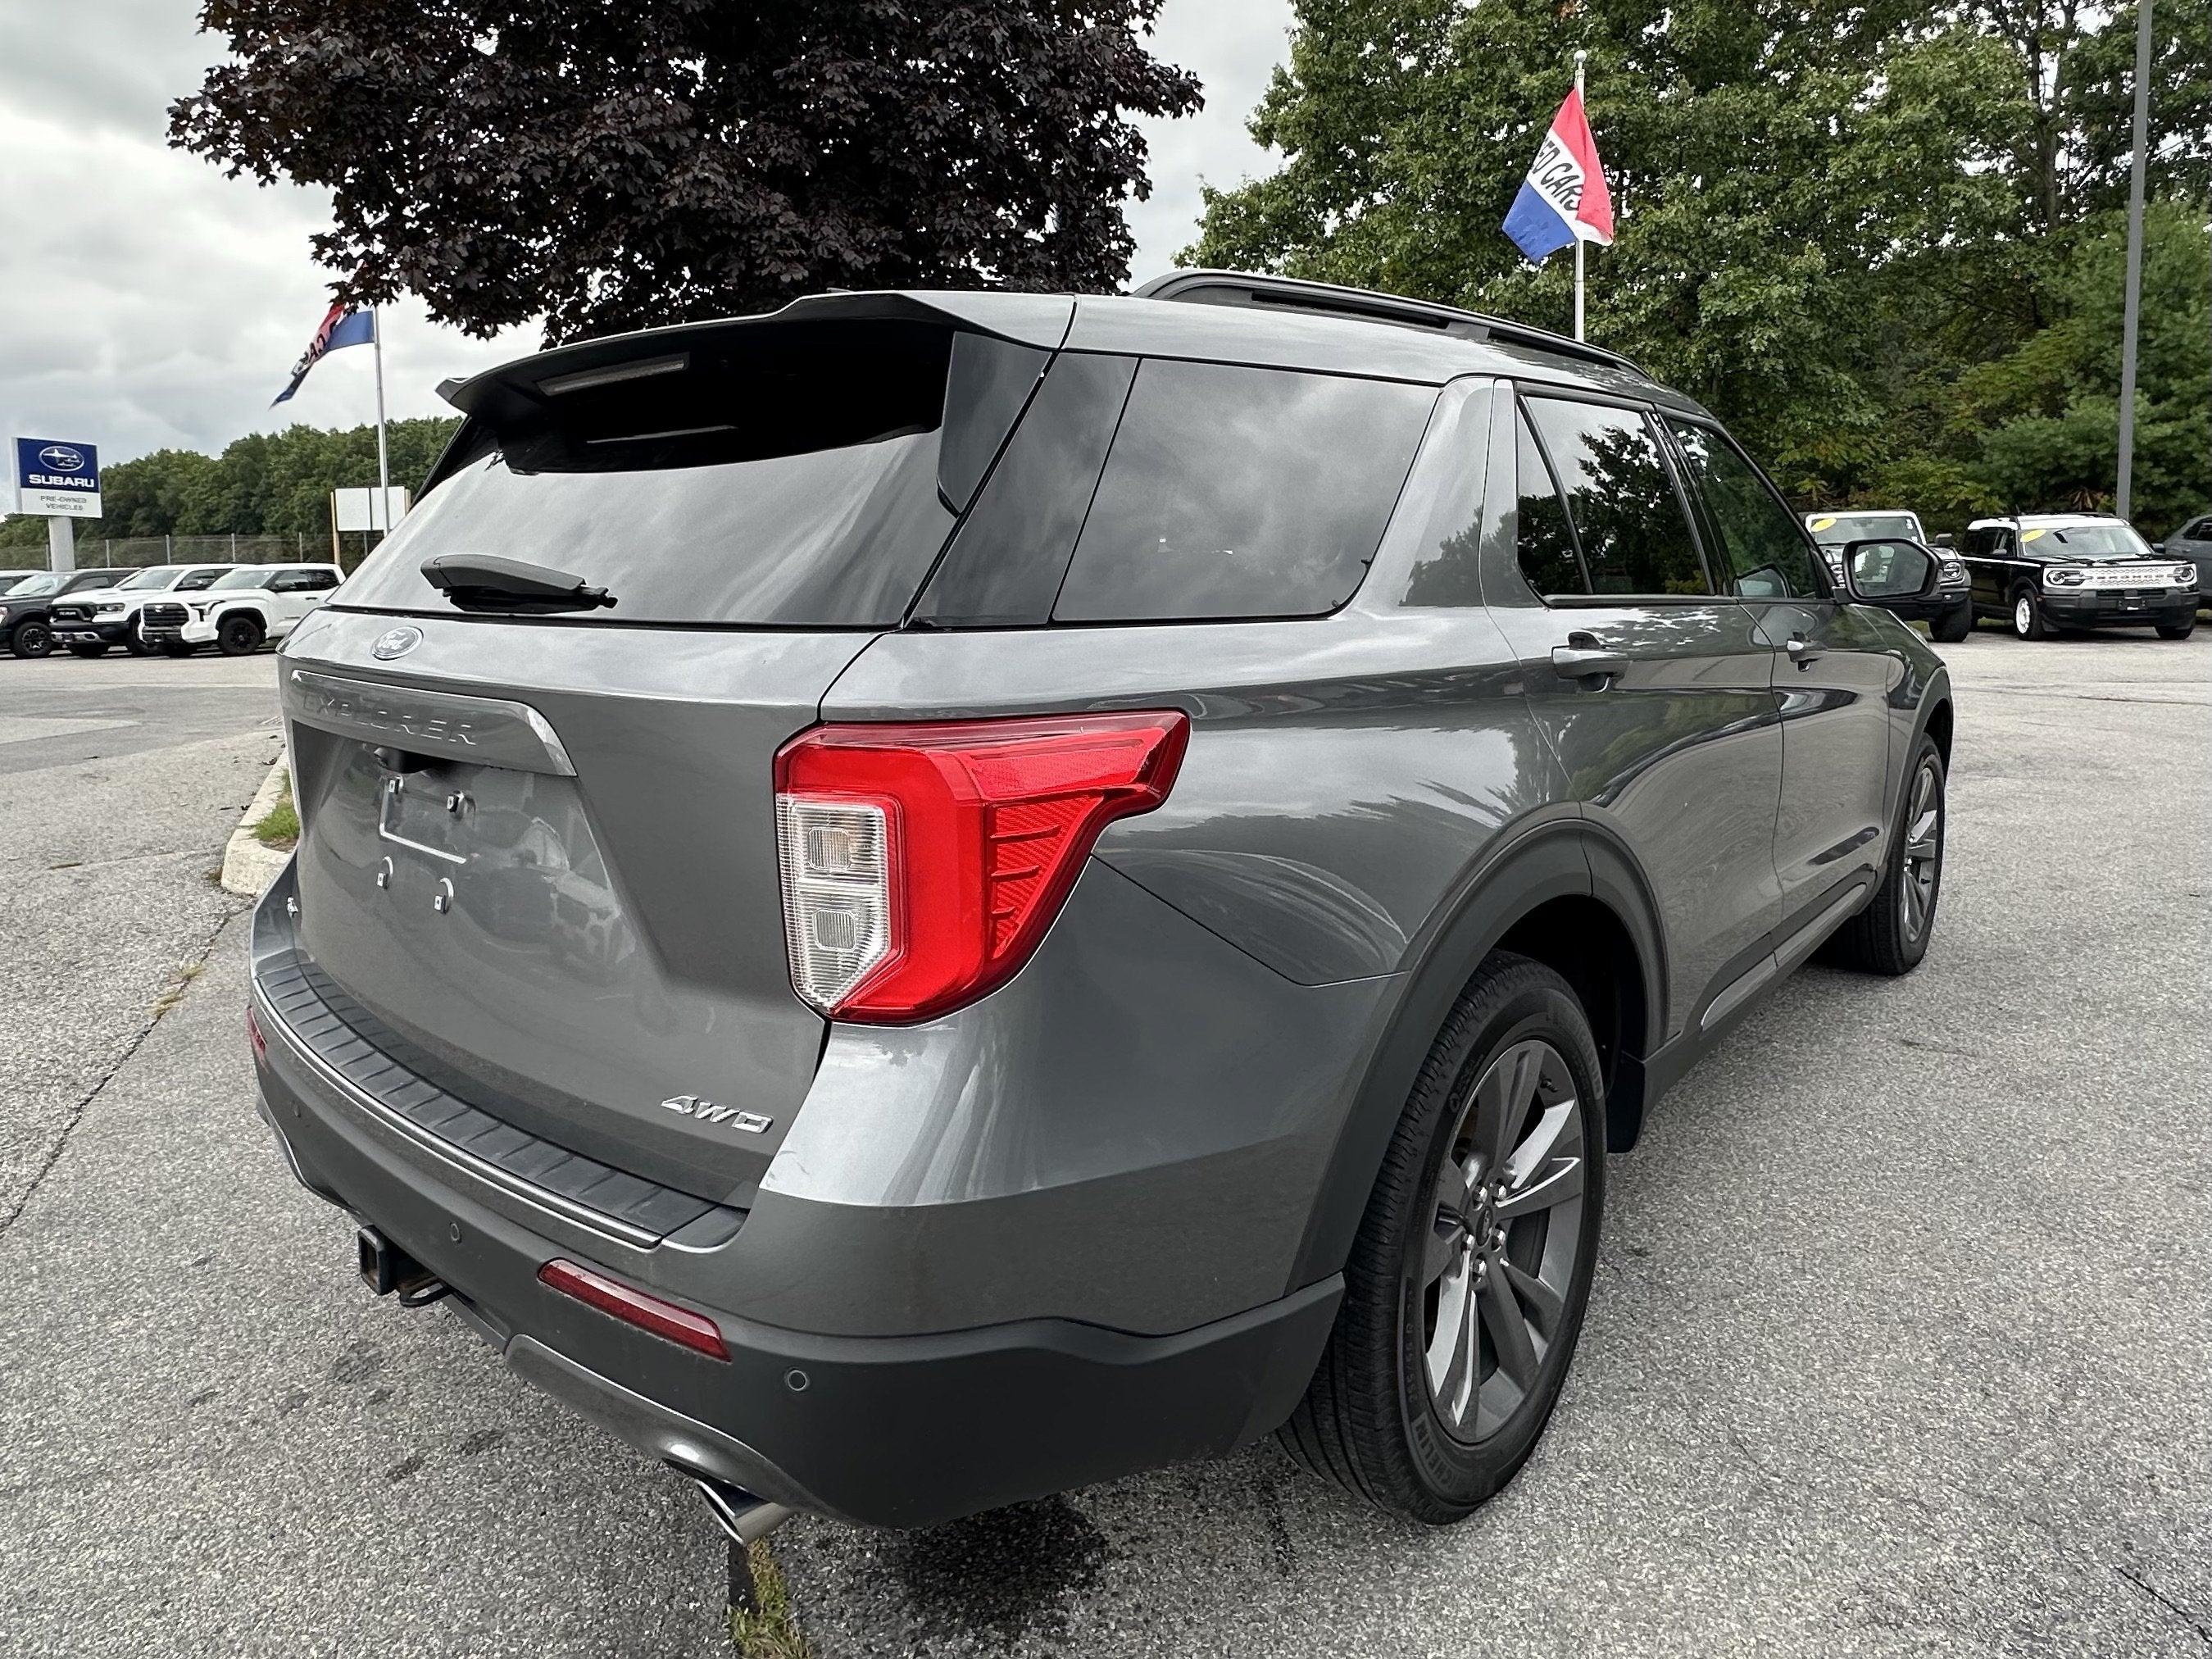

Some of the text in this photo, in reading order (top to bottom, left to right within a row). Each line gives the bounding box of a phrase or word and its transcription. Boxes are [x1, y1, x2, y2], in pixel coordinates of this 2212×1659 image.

[29, 474, 94, 488] SUBARU
[40, 495, 87, 503] PRE-OWNED
[45, 502, 83, 511] VEHICLES
[377, 630, 408, 650] Ford
[303, 691, 476, 746] EXPLORER
[661, 1095, 774, 1134] 4WD
[1412, 1417, 1470, 1493] ICHELIN
